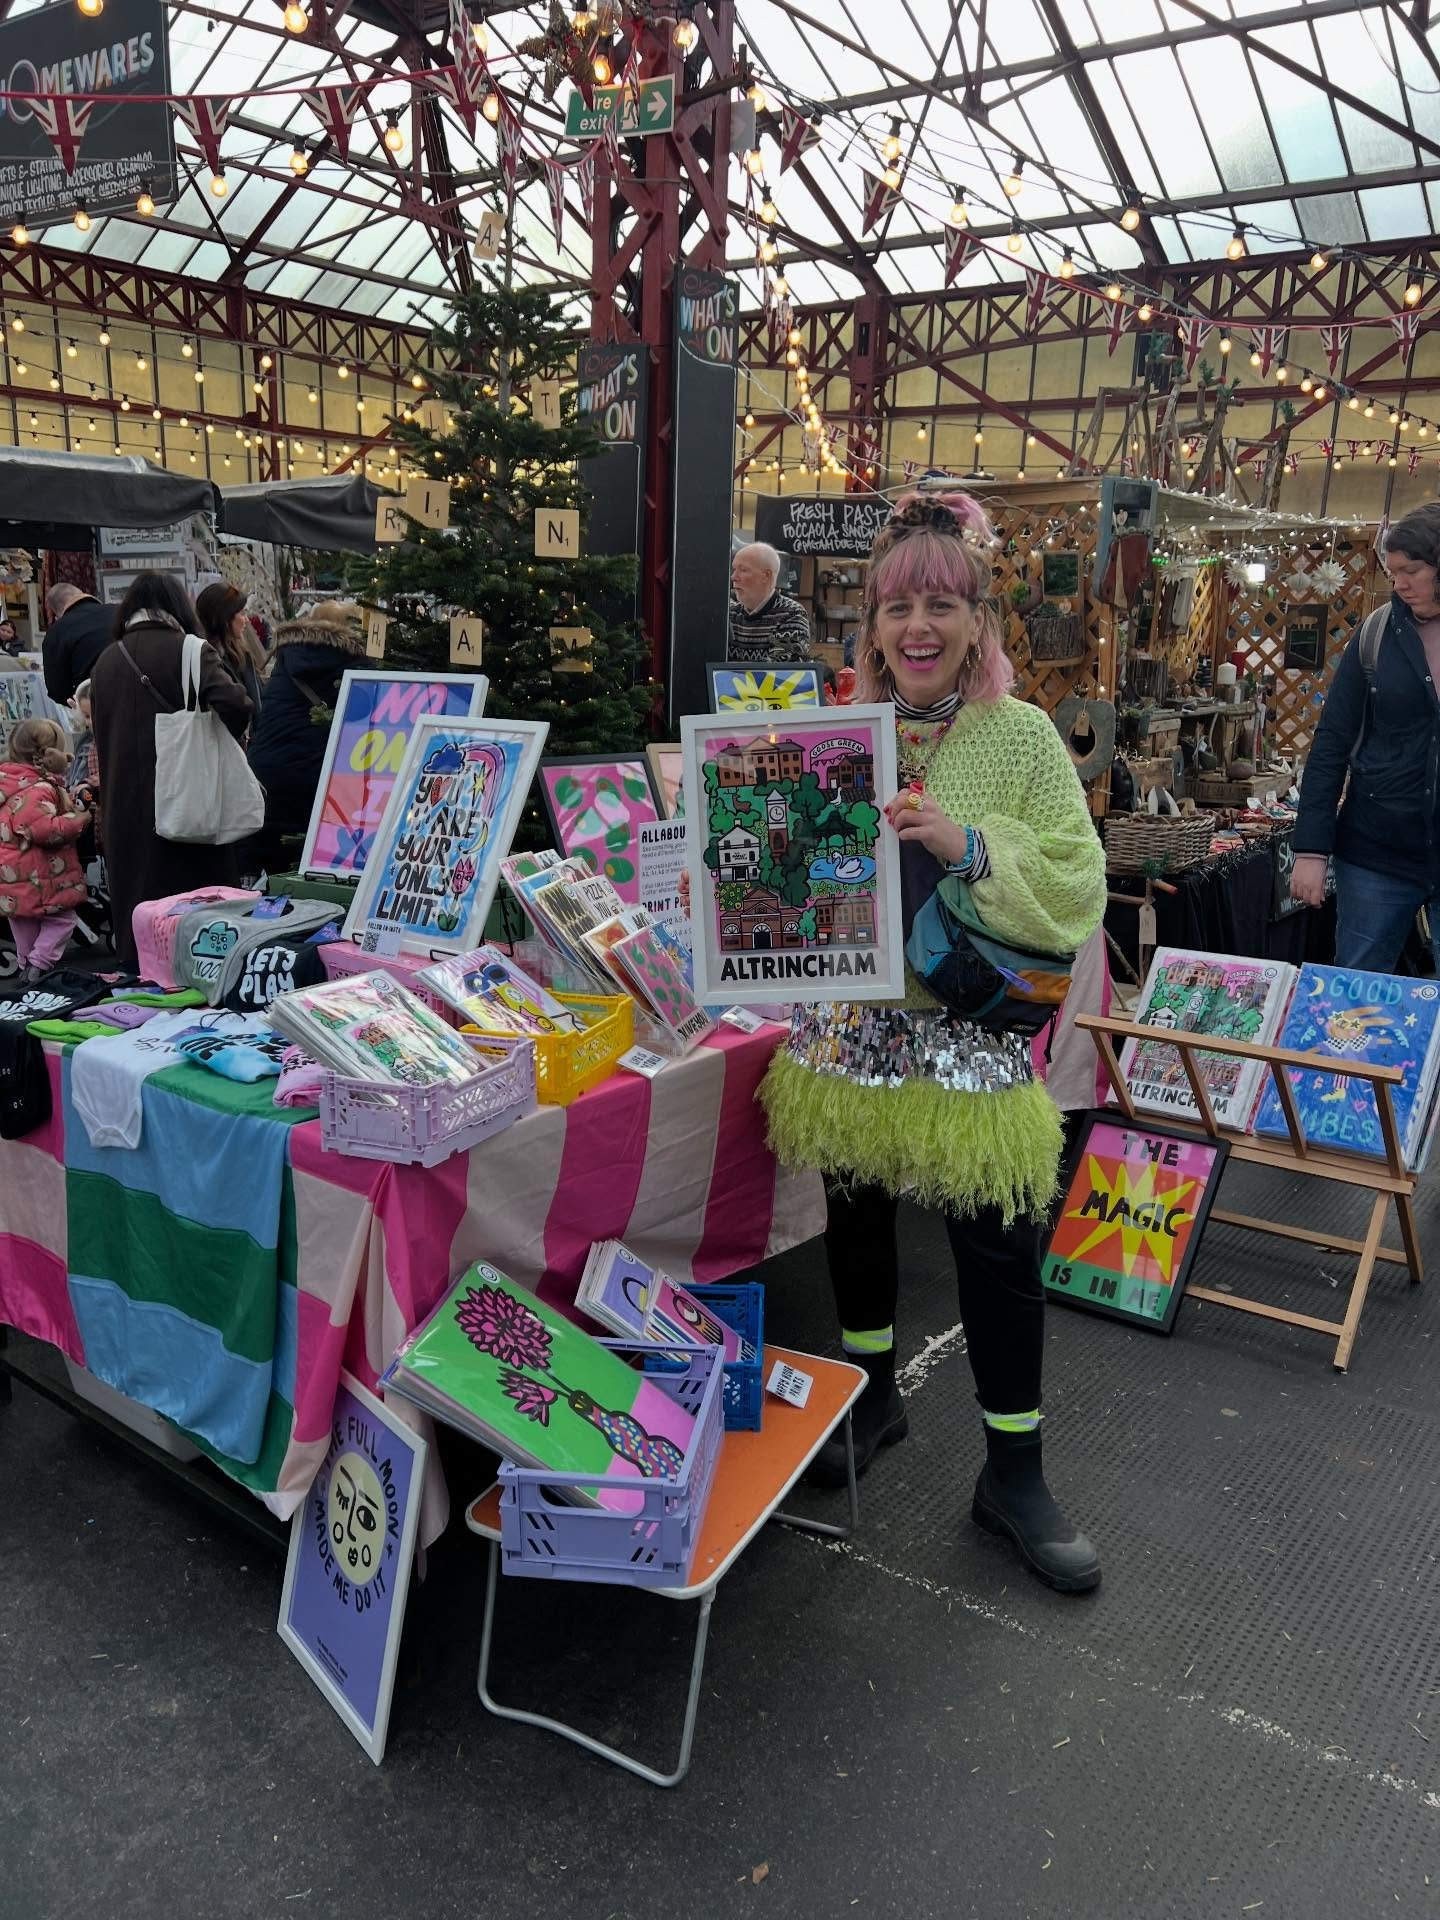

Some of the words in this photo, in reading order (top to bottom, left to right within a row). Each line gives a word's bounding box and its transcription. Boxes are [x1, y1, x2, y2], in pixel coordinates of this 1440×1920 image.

[580, 115, 608, 131] exit
[0, 181, 25, 201] NIQUE
[680, 284, 735, 332] WHAT'S
[706, 326, 734, 362] ON
[541, 393, 550, 416] T
[605, 400, 637, 441] ON
[790, 502, 835, 523] FRESH
[548, 520, 563, 544] N
[457, 629, 471, 652] A
[372, 683, 448, 725] NO
[350, 729, 408, 774] ON
[812, 740, 834, 757] GOOSE
[837, 740, 862, 752] GREEN
[428, 806, 482, 839] ARE
[394, 833, 452, 867] YOUR
[394, 862, 455, 898] ONLY
[582, 882, 608, 901] PIZZA
[375, 890, 438, 927] LIMIT
[593, 901, 612, 920] YOU
[720, 952, 877, 982] ALTRINCHAM
[239, 971, 296, 1004] PLAY
[1329, 974, 1403, 1006] GOOD
[1126, 1080, 1229, 1115] ALTRINCHM
[1122, 1131, 1182, 1167] THE
[1080, 1189, 1186, 1238] MAGIC
[1049, 1262, 1073, 1287] IS
[1088, 1275, 1119, 1301] IN
[1125, 1286, 1162, 1313] ME
[347, 1415, 378, 1464] FULL
[379, 1458, 400, 1540] MOON
[314, 1500, 335, 1577] MADE
[332, 1572, 350, 1606] ME
[354, 1586, 371, 1614] DO
[373, 1567, 387, 1601] IT
